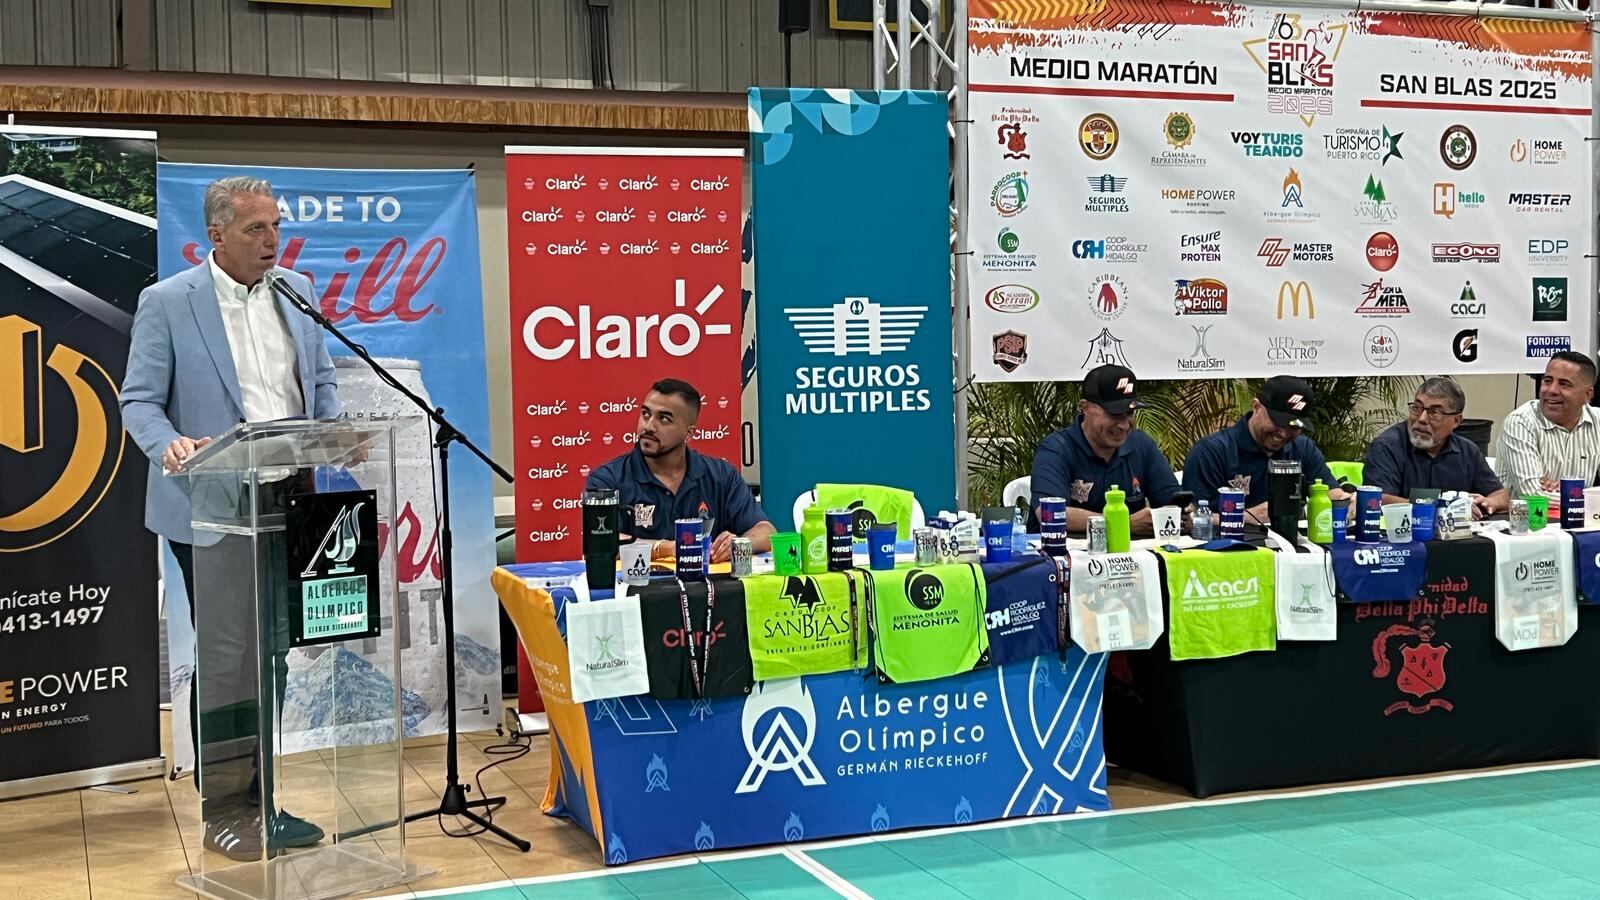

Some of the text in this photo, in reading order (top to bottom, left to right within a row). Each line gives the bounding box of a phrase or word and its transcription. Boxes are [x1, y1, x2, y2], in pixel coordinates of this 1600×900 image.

[1268, 42, 1307, 61] SAN
[1010, 57, 1217, 85] MEDIO MARATÓN
[1380, 74, 1557, 100] SAN BLAS 2025
[1268, 95, 1333, 115] 2025
[1323, 135, 1380, 151] TURISMO
[1534, 140, 1562, 150] HOME
[1243, 145, 1303, 157] TEANDO
[1327, 151, 1380, 160] PUERTO RICO
[1534, 150, 1567, 160] POWER
[1151, 157, 1207, 165] REPRESENTANTES
[546, 177, 726, 191] Claro Claro Claro
[1196, 190, 1236, 201] POWER
[1458, 191, 1485, 203] hello
[1508, 193, 1572, 206] MASTER
[275, 195, 401, 222] ADE TO
[1085, 204, 1129, 212] MULTIPLES
[522, 209, 703, 222] Claro Claro Claro
[1181, 230, 1222, 248] Ensure
[548, 241, 726, 255] Claro Claro Claro
[1201, 244, 1220, 252] MAX
[1293, 243, 1333, 252] MASTER
[1368, 245, 1395, 257] Claro
[1434, 245, 1498, 257] ECONO
[1529, 240, 1569, 254] EDP
[1181, 253, 1221, 262] PROTEIN
[1293, 253, 1334, 261] MOTORS
[1088, 274, 1128, 294] CARIBBEAN
[1188, 286, 1225, 298] Viktor
[1193, 298, 1222, 309] Pollo
[1375, 295, 1408, 307] META
[523, 290, 718, 361] Claro
[1269, 337, 1294, 348] MED
[1528, 337, 1570, 345] FONDISTA
[1267, 347, 1318, 360] CENTRO
[1371, 345, 1393, 354] ROJAS
[1531, 348, 1567, 357] VIAJE
[1178, 358, 1225, 368] NaturalSlim
[796, 364, 920, 389] SEGUROS
[527, 399, 636, 416] Claro Claro
[785, 389, 931, 414] MULTIPLES
[552, 427, 726, 447] Claro Claro
[529, 465, 566, 479] Claro
[530, 528, 567, 543] Claro
[1107, 556, 1134, 564] HOME
[1533, 560, 1556, 569] HOME
[1110, 562, 1140, 572] POWER
[1534, 567, 1560, 576] POWER
[69, 584, 111, 603] Hoy
[308, 580, 366, 600] ALBERGUE
[922, 585, 943, 601] SSM
[308, 601, 363, 620] OLIMPICO
[1010, 599, 1028, 610] COOP
[1290, 605, 1324, 614] NaturalSlim
[1408, 596, 1439, 622] Phi
[893, 612, 923, 621] SISTEMA
[935, 609, 959, 617] SALUD
[1011, 610, 1040, 623] HIDALGO
[893, 616, 960, 631] MENONITA
[586, 658, 629, 671] NaturalSlim
[21, 666, 128, 701] POWER
[16, 702, 67, 717] ENERGY
[836, 690, 988, 721] Albergue
[13, 722, 43, 732] FUTURO
[44, 719, 63, 727] PARA
[839, 721, 985, 753] Olímpico
[837, 752, 989, 777] GERMÁN RIECKEHOFF
